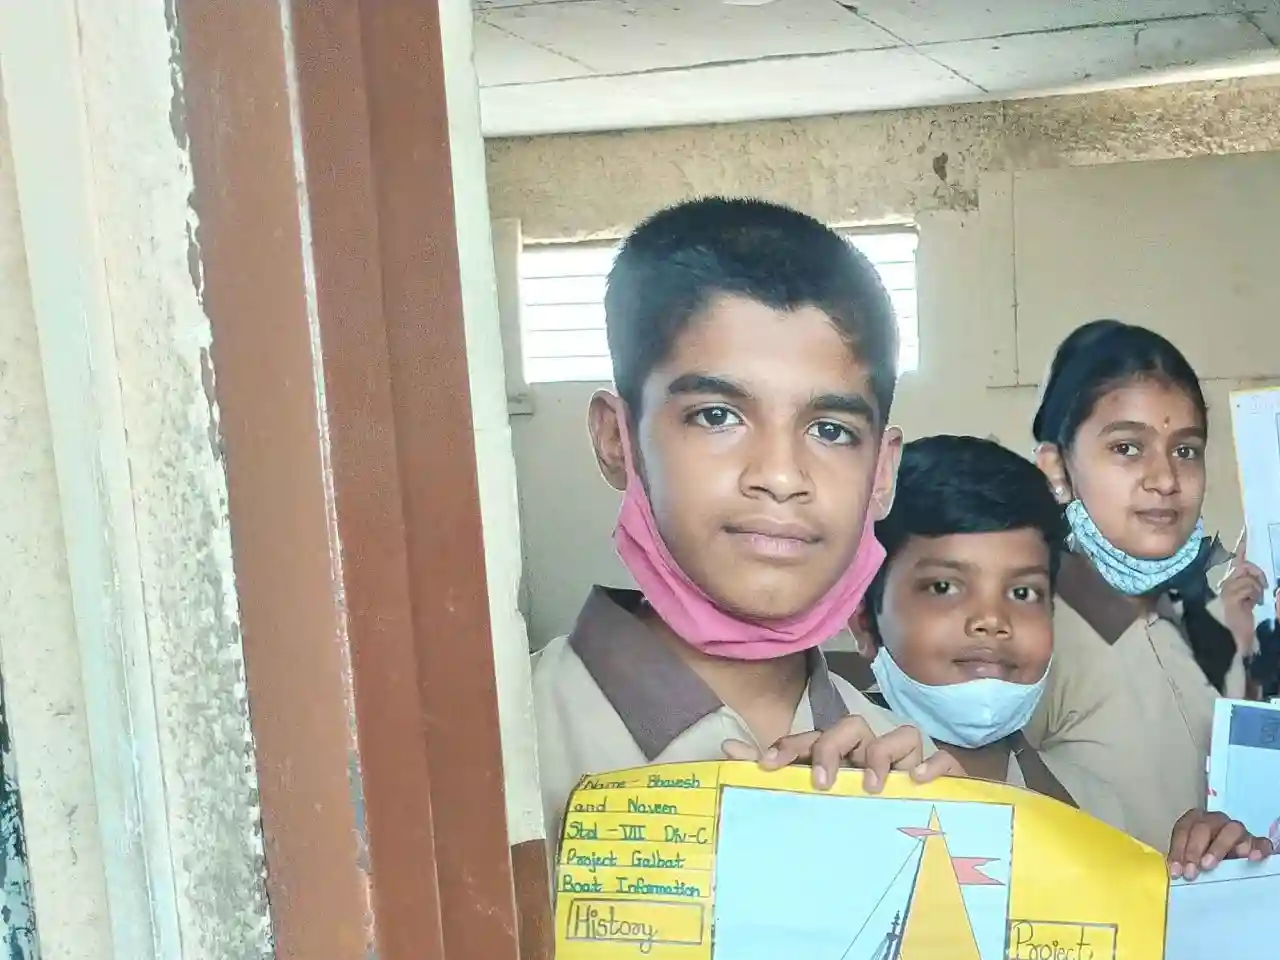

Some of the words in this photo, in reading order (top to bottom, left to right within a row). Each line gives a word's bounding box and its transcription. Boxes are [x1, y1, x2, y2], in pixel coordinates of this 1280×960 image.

[575, 796, 607, 812] and
[628, 797, 677, 813] Naveen
[567, 821, 597, 839] Std
[566, 848, 617, 872] Project
[632, 850, 686, 868] Galbat
[563, 875, 602, 892] Boat
[616, 877, 699, 896] Information
[574, 905, 658, 952] History
